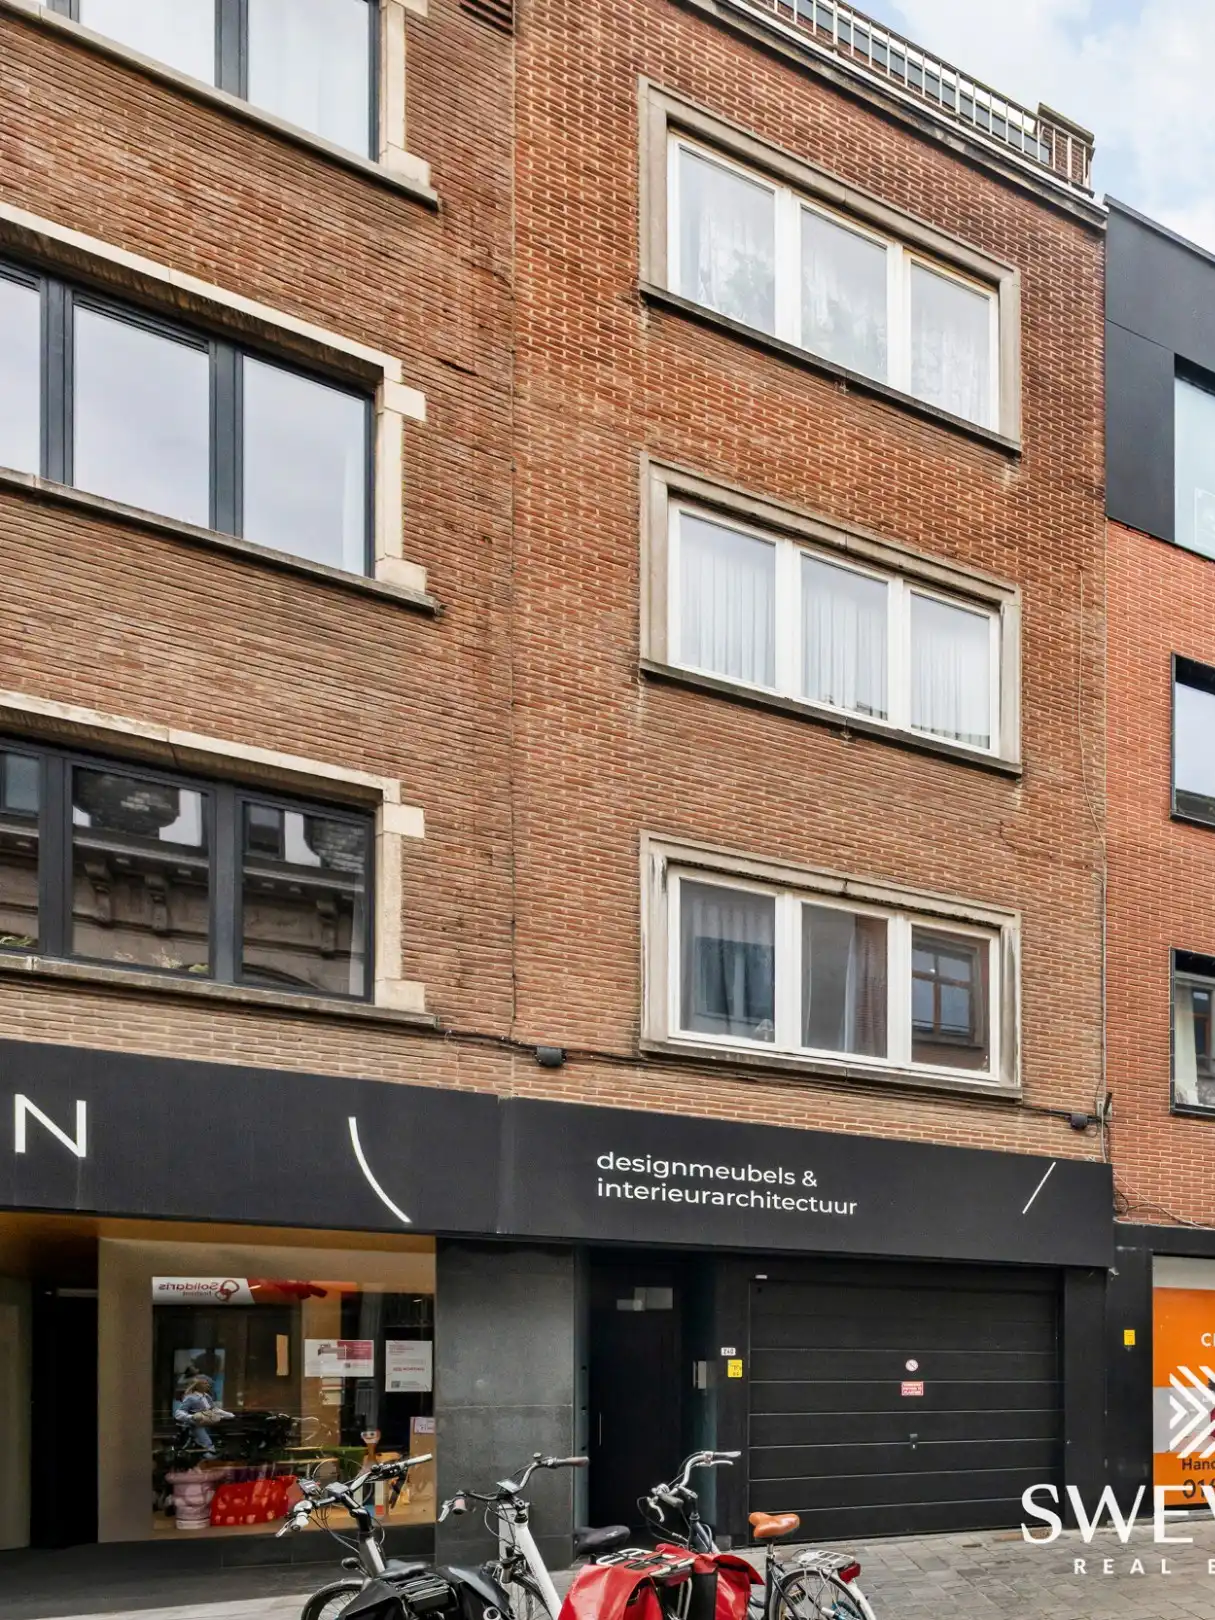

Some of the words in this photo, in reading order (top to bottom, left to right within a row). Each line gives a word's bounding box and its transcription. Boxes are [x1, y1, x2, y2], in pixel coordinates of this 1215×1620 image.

[14, 1092, 87, 1158] N
[596, 1151, 796, 1186] designmeubels
[801, 1169, 818, 1188] &
[597, 1177, 858, 1215] interieurarchitectuur
